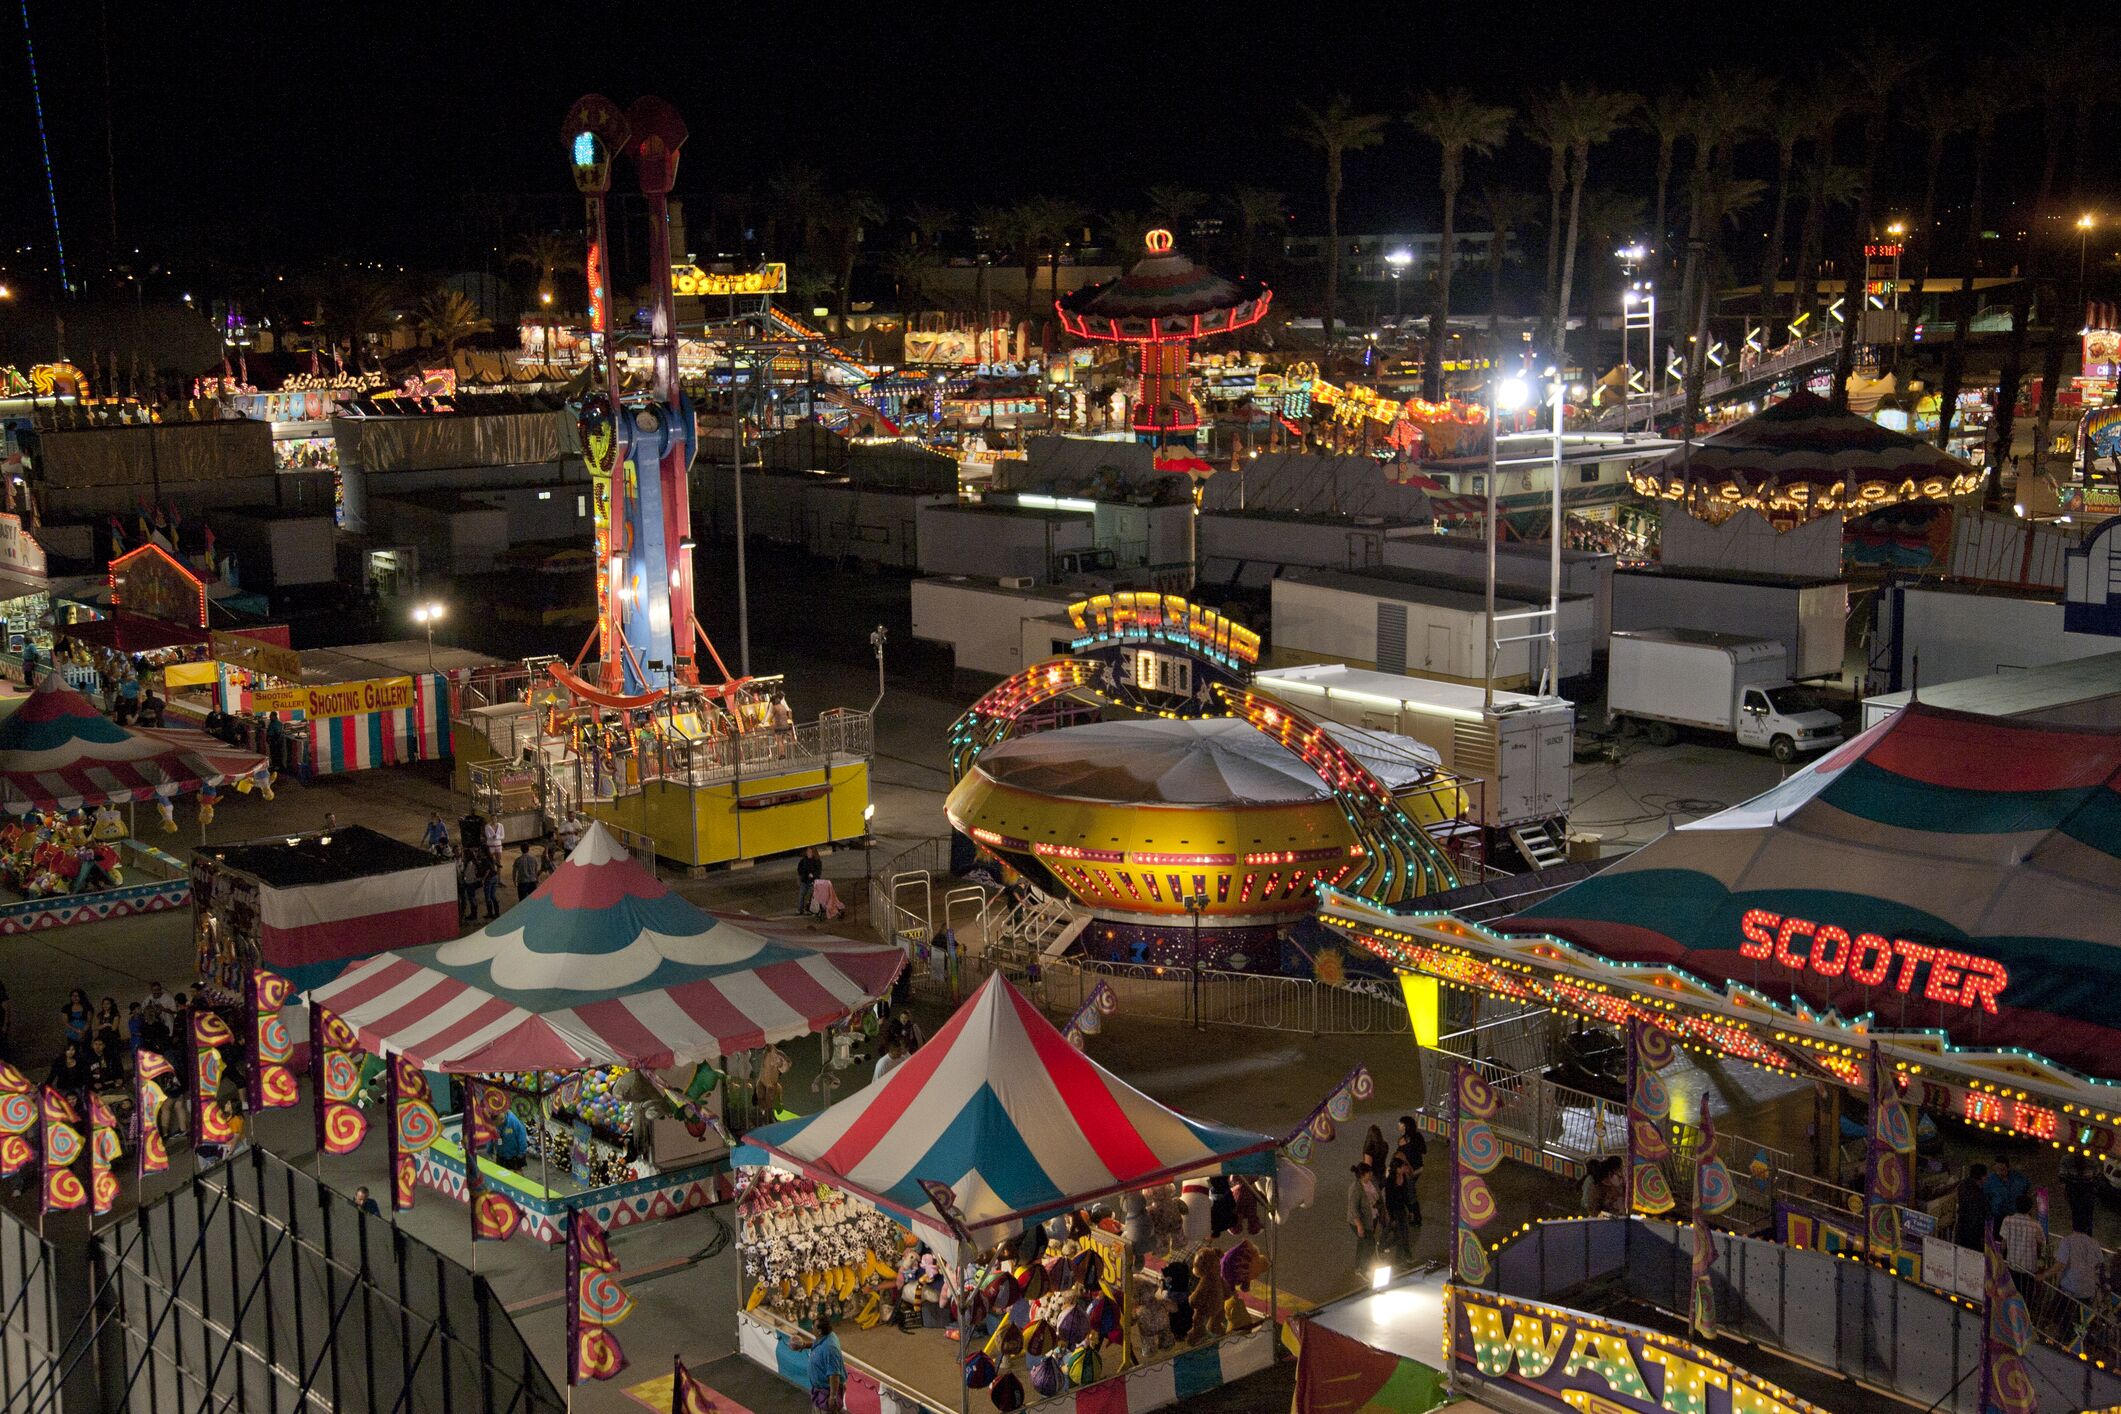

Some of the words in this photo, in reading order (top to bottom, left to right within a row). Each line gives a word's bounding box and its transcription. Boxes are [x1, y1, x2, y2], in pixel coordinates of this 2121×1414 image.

[1068, 591, 1261, 671] STARSHIP
[1120, 646, 1193, 698] 3000
[1739, 908, 2008, 1015] SCOOTER
